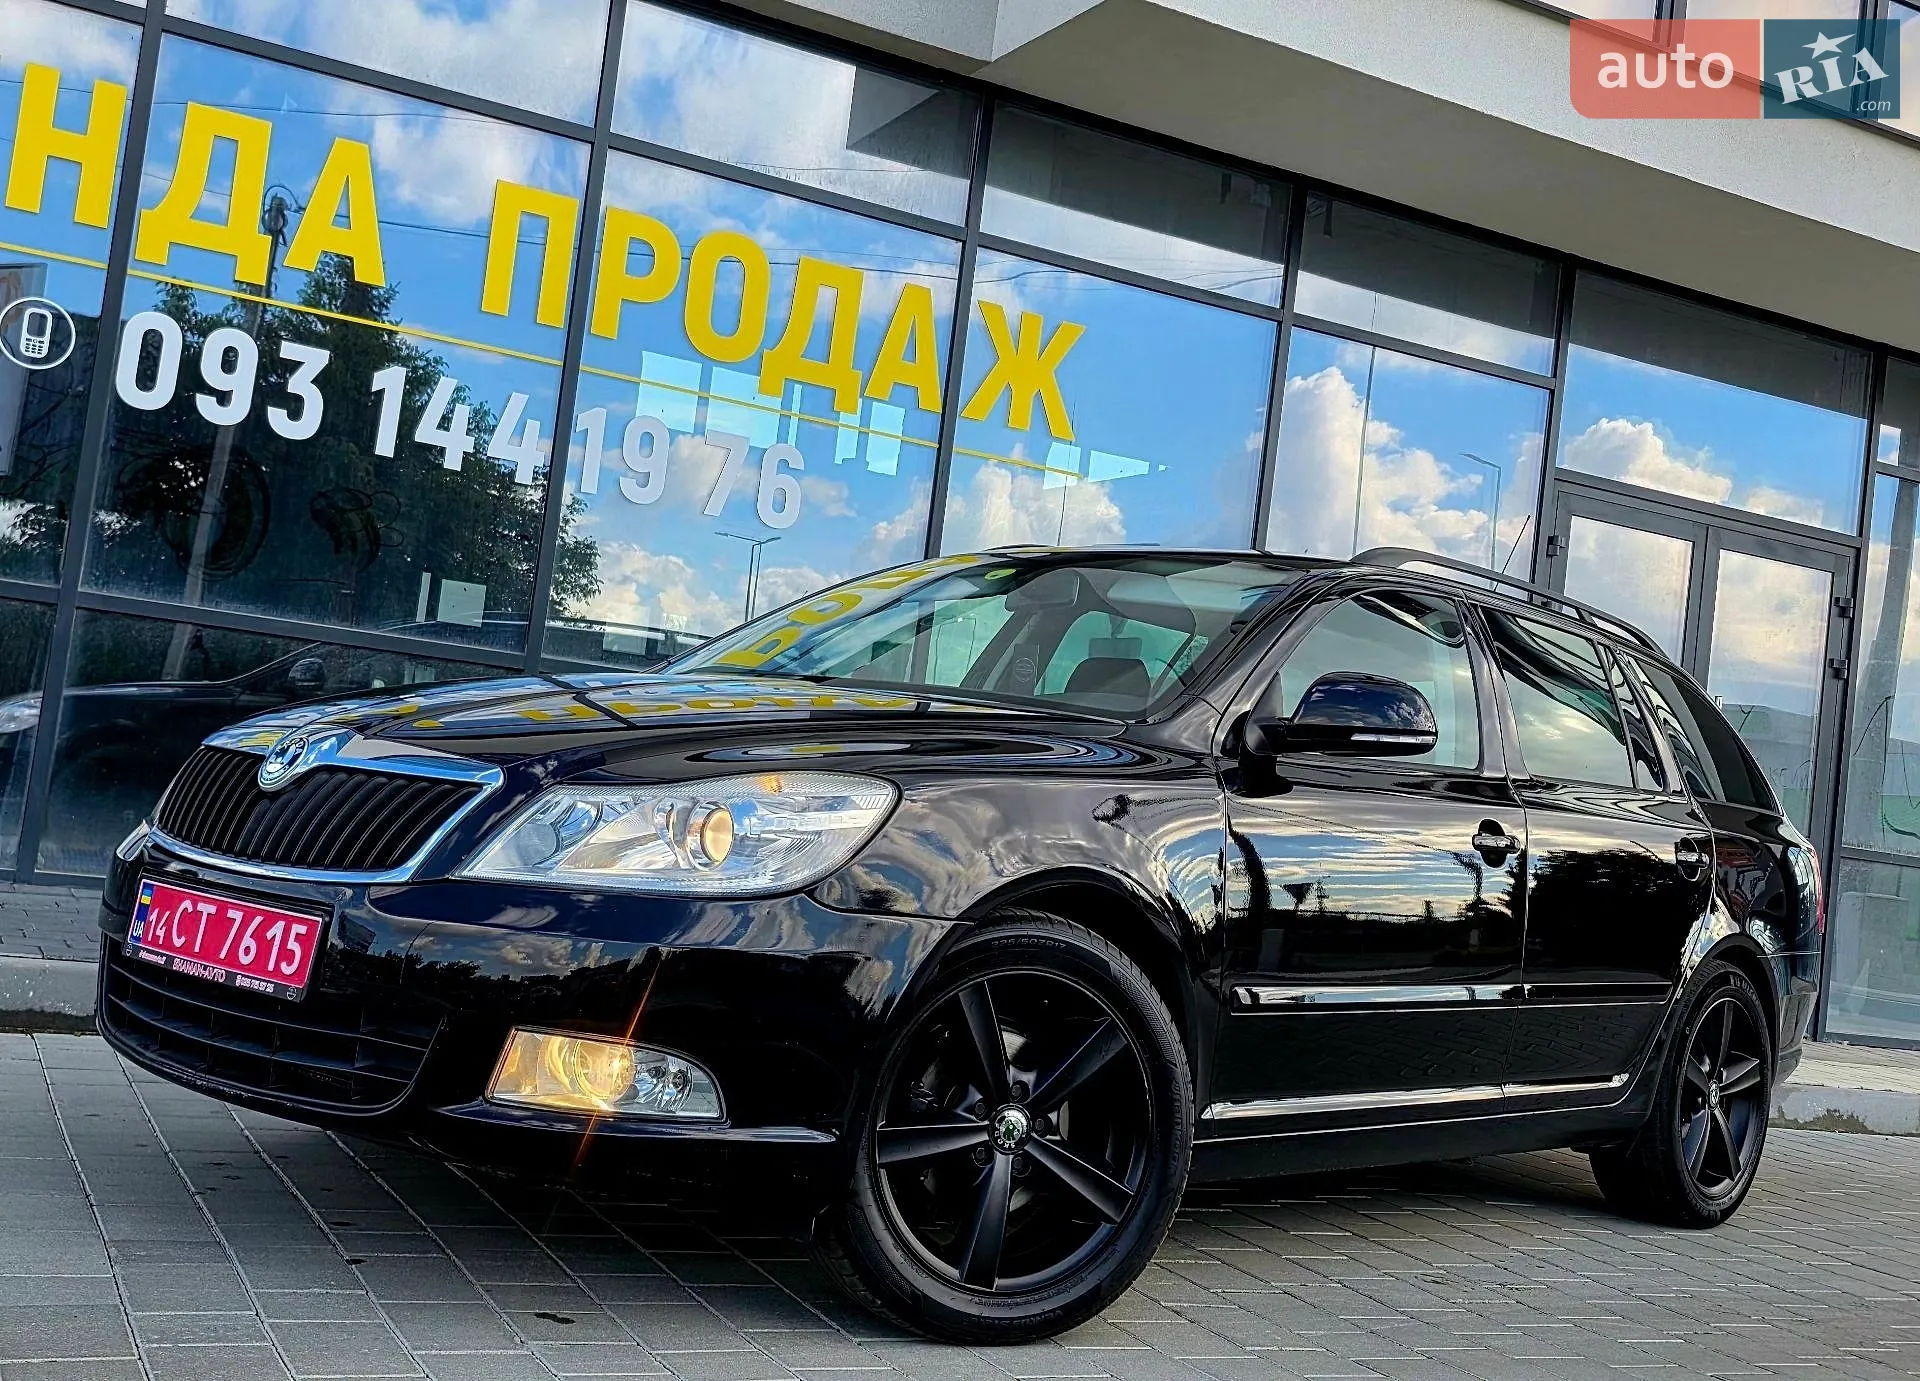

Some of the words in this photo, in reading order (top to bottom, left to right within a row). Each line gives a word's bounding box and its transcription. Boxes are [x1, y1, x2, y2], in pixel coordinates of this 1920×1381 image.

[5, 62, 386, 287] НДА
[480, 178, 1086, 441] ПРОДАЖ
[115, 312, 331, 440] 093
[372, 365, 546, 486] 144
[575, 406, 671, 505] 19
[703, 430, 806, 529] 76
[133, 920, 144, 938] UA
[219, 909, 307, 976] 7615
